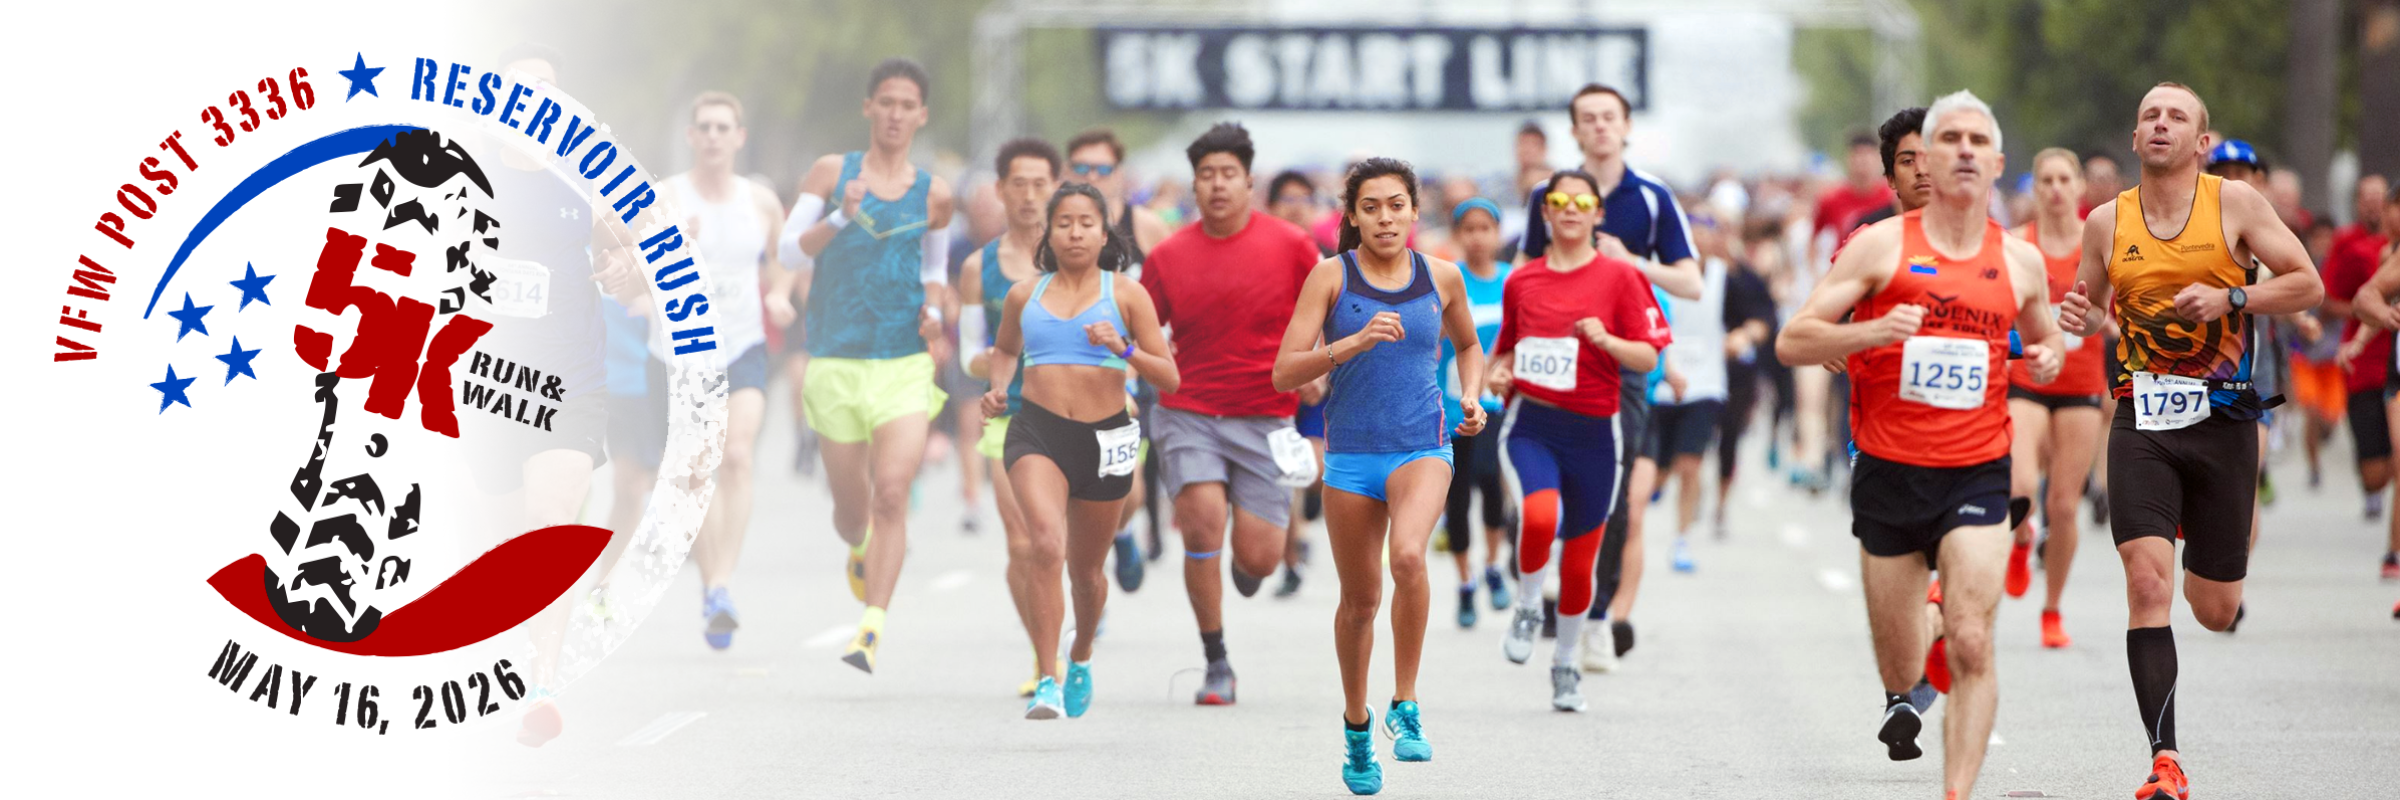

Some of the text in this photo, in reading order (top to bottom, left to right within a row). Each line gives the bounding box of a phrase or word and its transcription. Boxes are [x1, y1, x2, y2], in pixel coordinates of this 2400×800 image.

[1223, 32, 1453, 108] START
[1469, 32, 1638, 108] LINE
[1520, 352, 1573, 375] 1607
[1908, 361, 1983, 392] 1255
[2140, 390, 2204, 416] 1797
